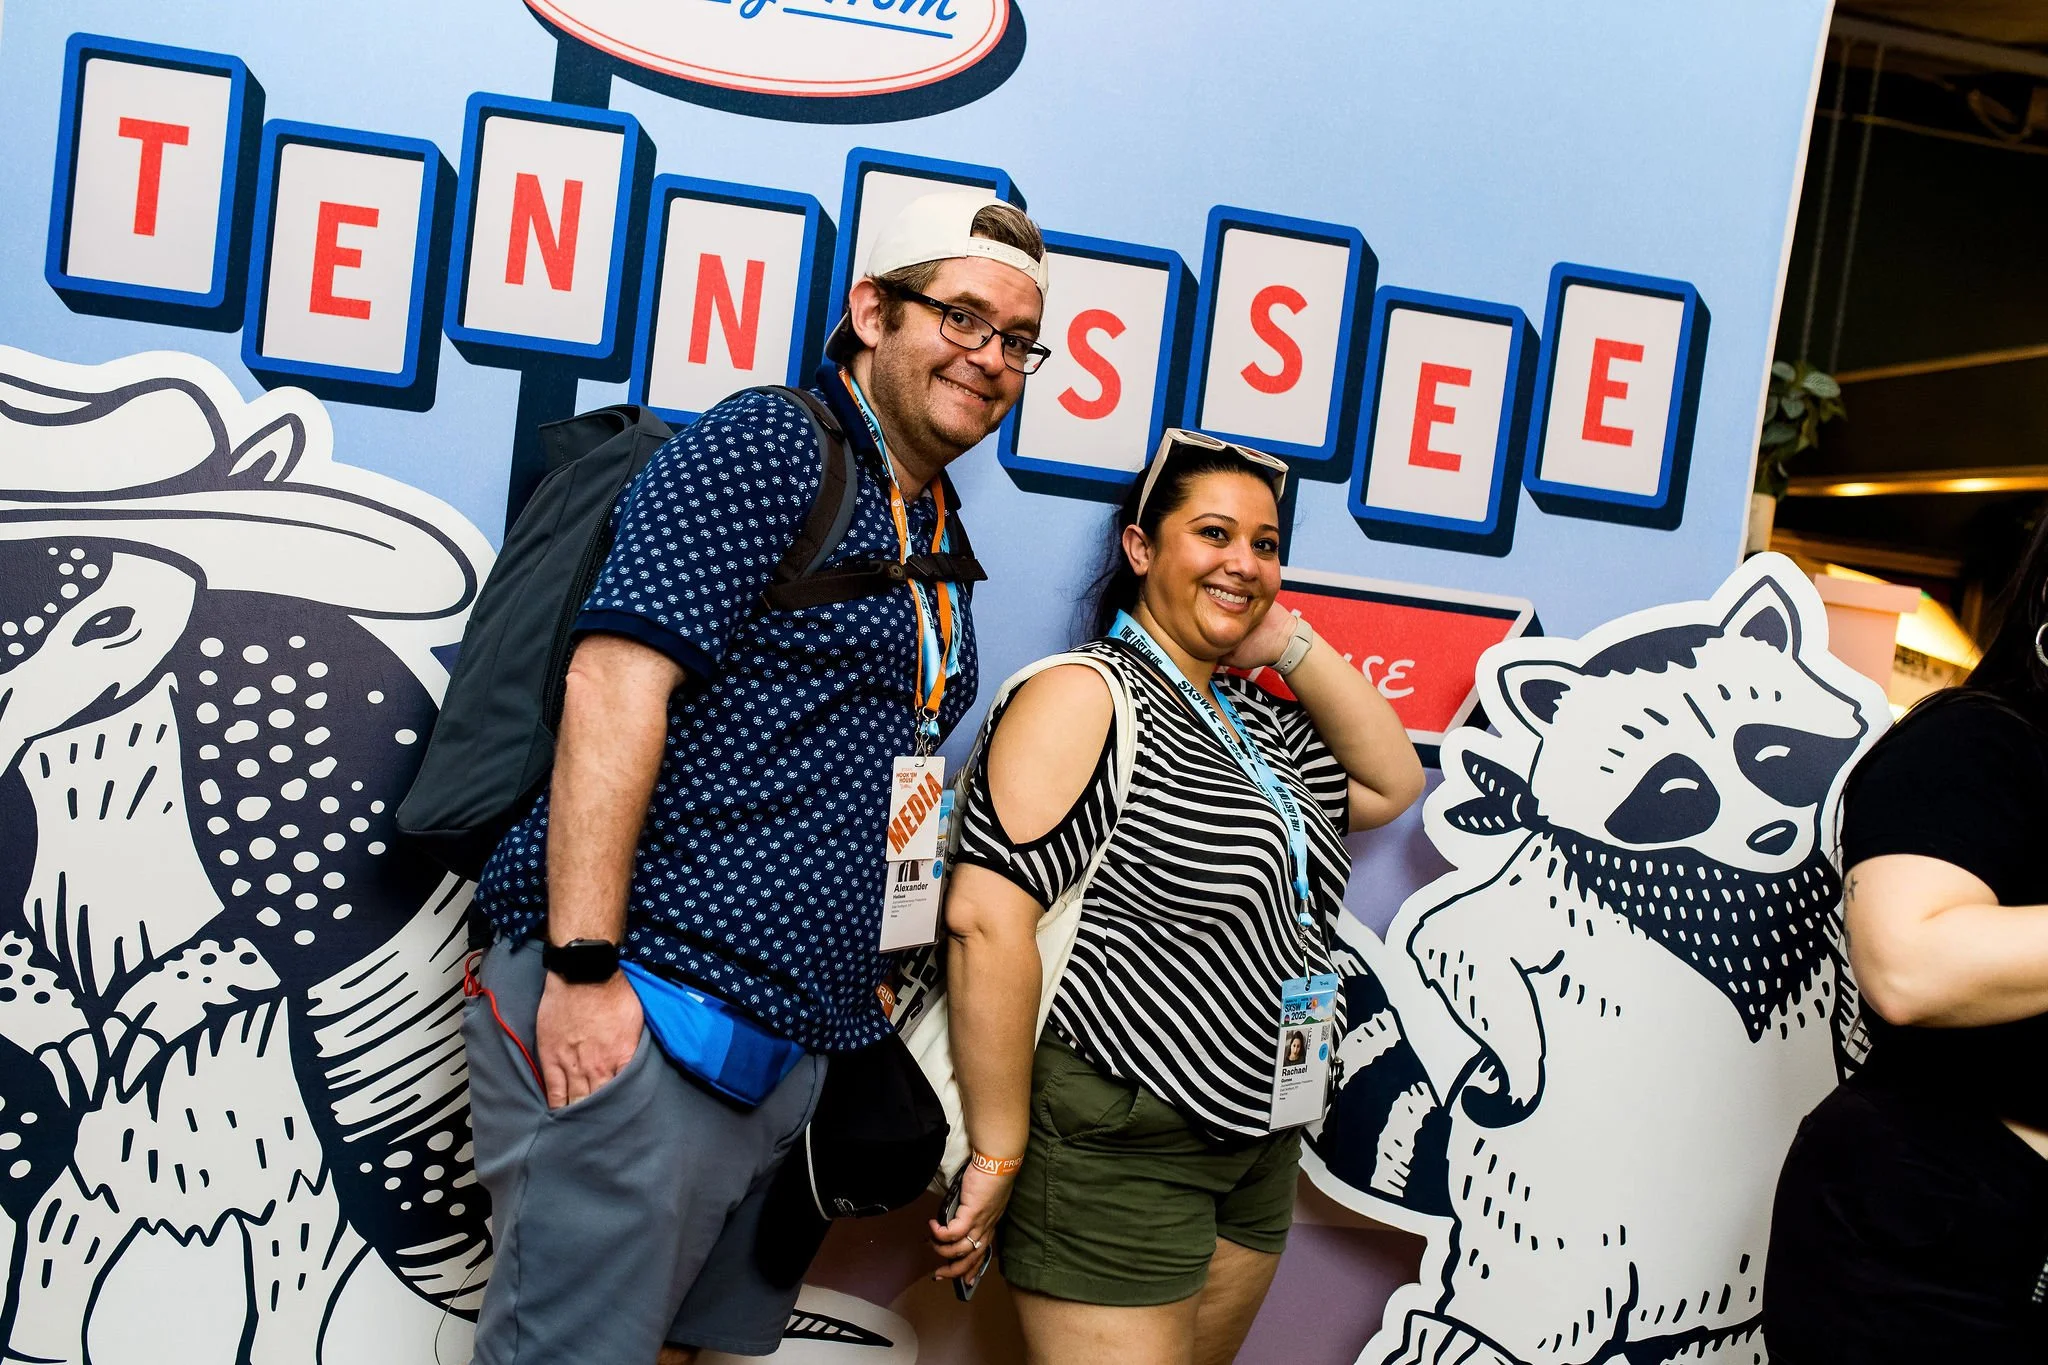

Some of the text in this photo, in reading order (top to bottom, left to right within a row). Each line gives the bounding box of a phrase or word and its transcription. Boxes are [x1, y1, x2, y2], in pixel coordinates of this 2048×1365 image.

[117, 116, 1645, 473] TENNSSEE
[1120, 625, 1135, 641] THE
[1130, 635, 1147, 653] LAST
[1228, 711, 1242, 726] TV
[888, 772, 943, 855] MEDIA
[1283, 801, 1298, 818] LAST
[1290, 818, 1300, 832] THE
[893, 882, 928, 893] Alexander
[1284, 1002, 1301, 1012] SXSW
[1291, 1011, 1307, 1020] 2025
[1281, 1065, 1308, 1077] Rachael
